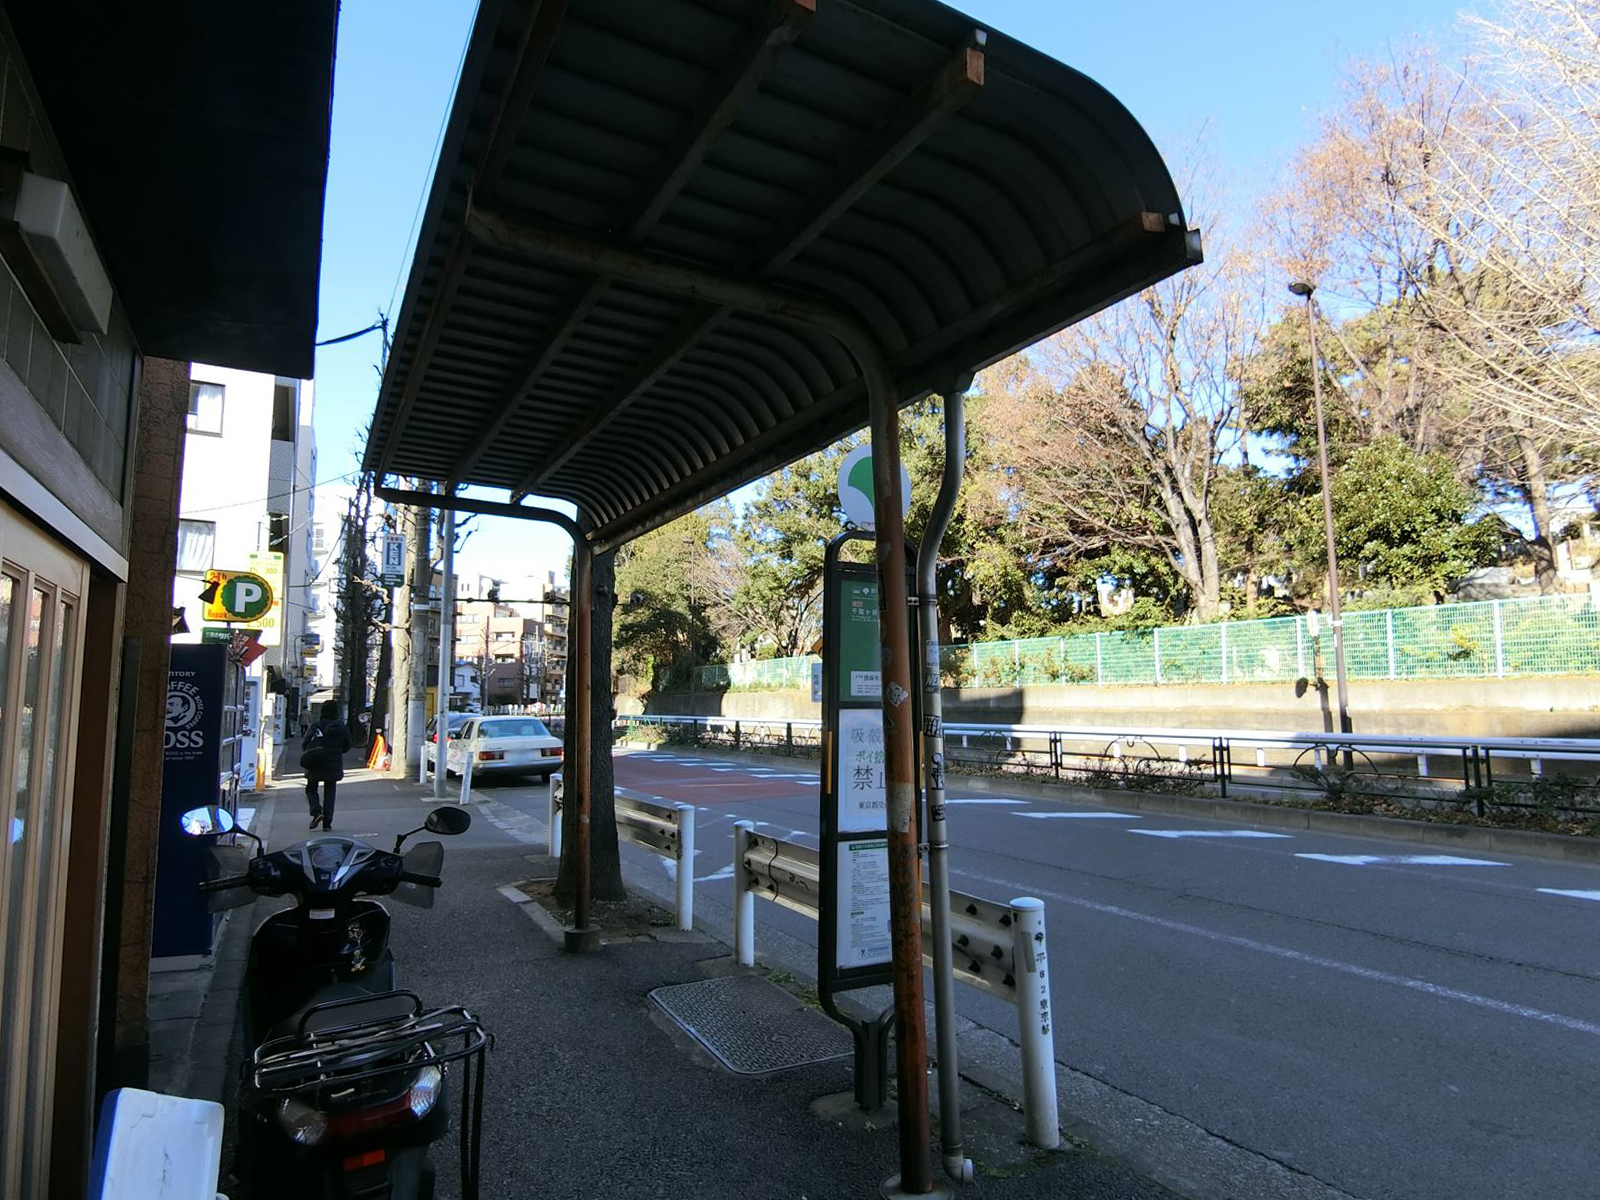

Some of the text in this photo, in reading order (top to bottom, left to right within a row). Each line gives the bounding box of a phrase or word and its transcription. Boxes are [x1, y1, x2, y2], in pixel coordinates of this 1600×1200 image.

[389, 543, 399, 565] KEN
[235, 582, 262, 612] P
[168, 681, 200, 696] FFEE
[164, 730, 204, 748] OSS
